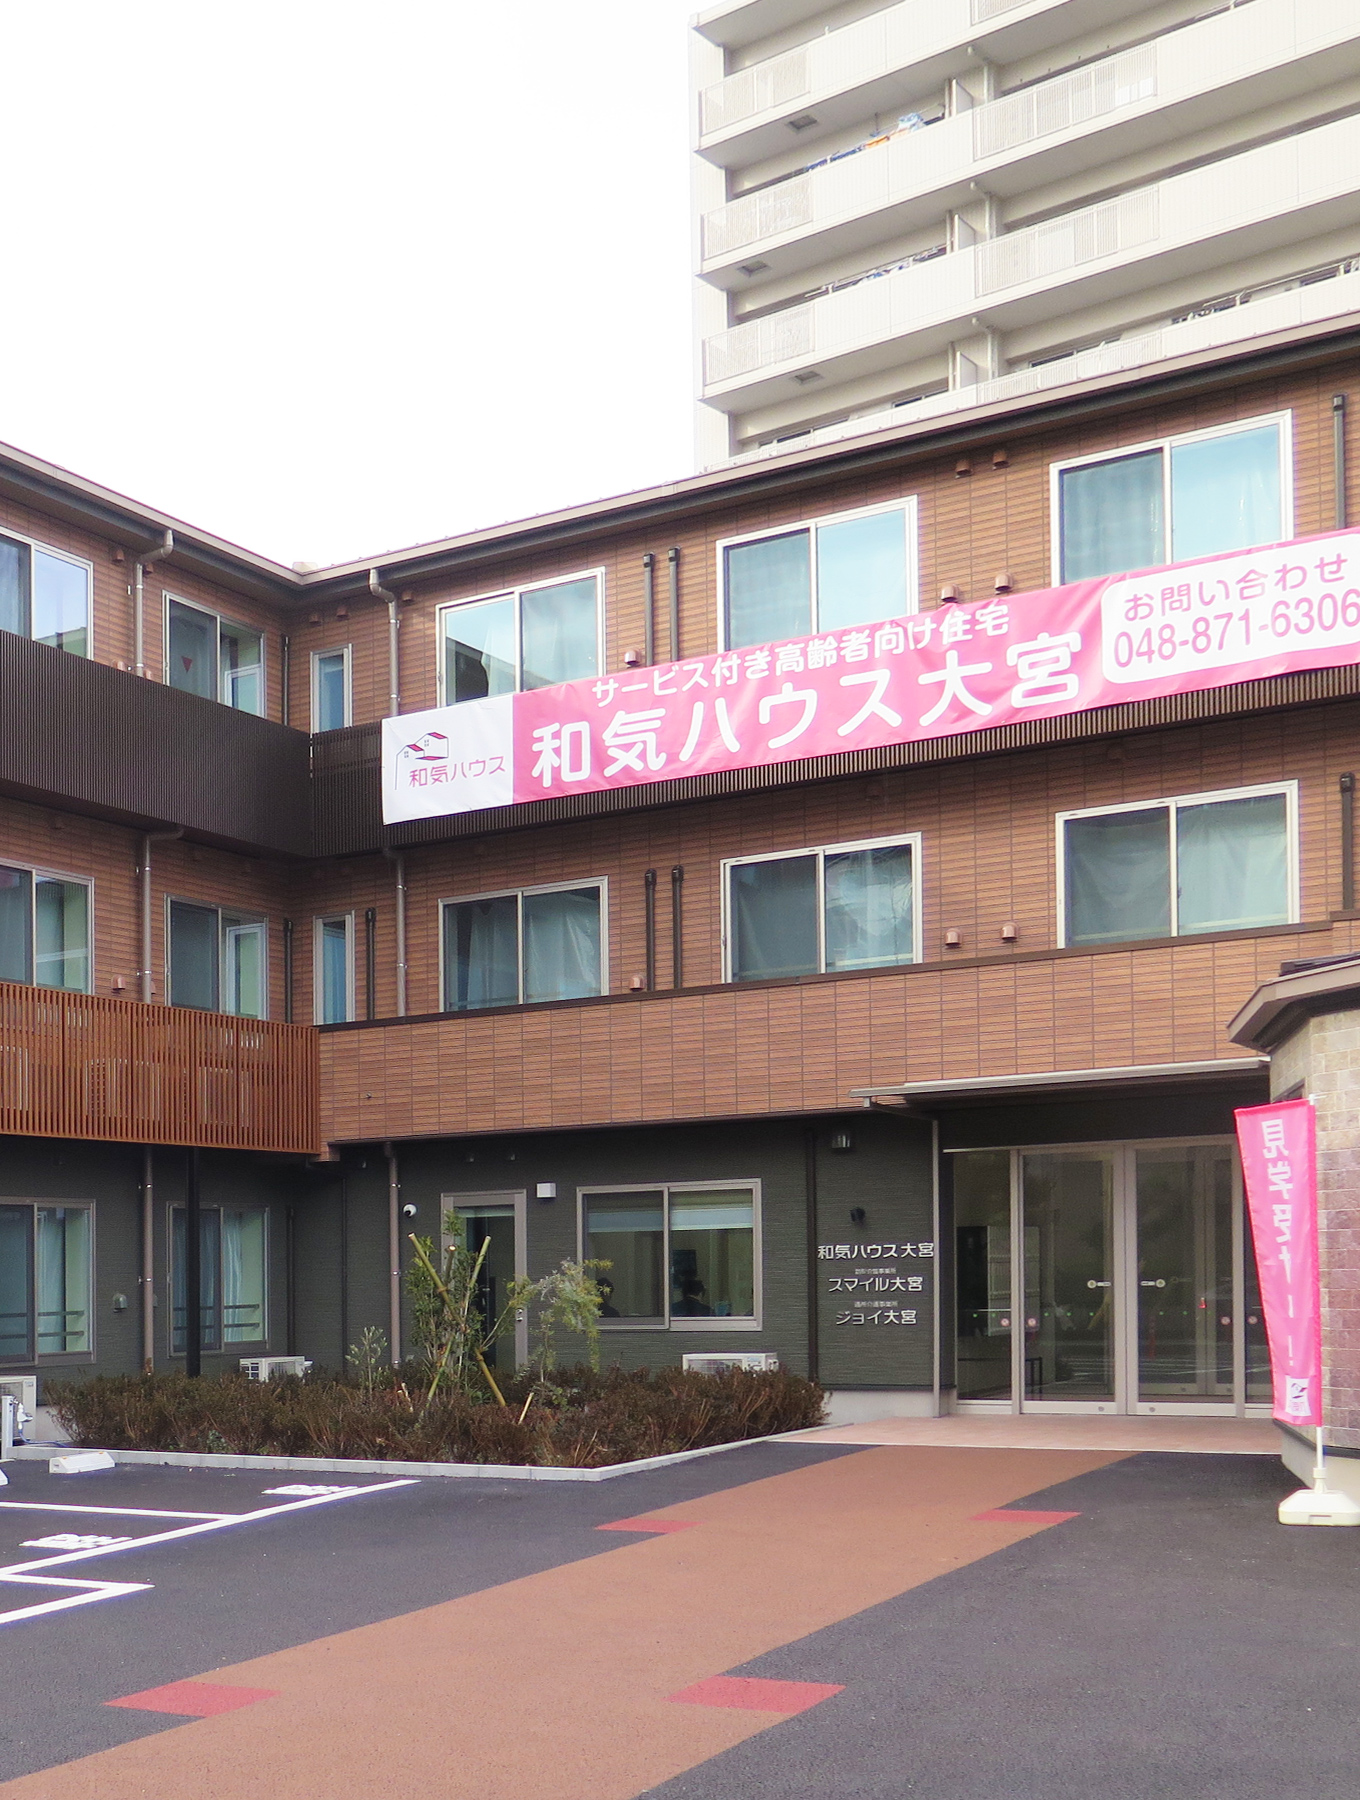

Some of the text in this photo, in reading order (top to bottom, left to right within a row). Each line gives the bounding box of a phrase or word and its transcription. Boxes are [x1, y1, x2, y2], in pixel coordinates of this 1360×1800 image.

[1124, 553, 1348, 622] お問い合わせ
[1114, 588, 1360, 668] 048-871-6306
[592, 605, 1010, 708] サービス付き高齢者向け住宅
[531, 631, 1083, 788] 和気ハウス大宮
[408, 755, 506, 788] 和気ハウス
[817, 1242, 935, 1260] 和気ハウス大宮
[828, 1276, 924, 1292] スマイル大宮
[835, 1309, 918, 1325] ジョイ大宮
